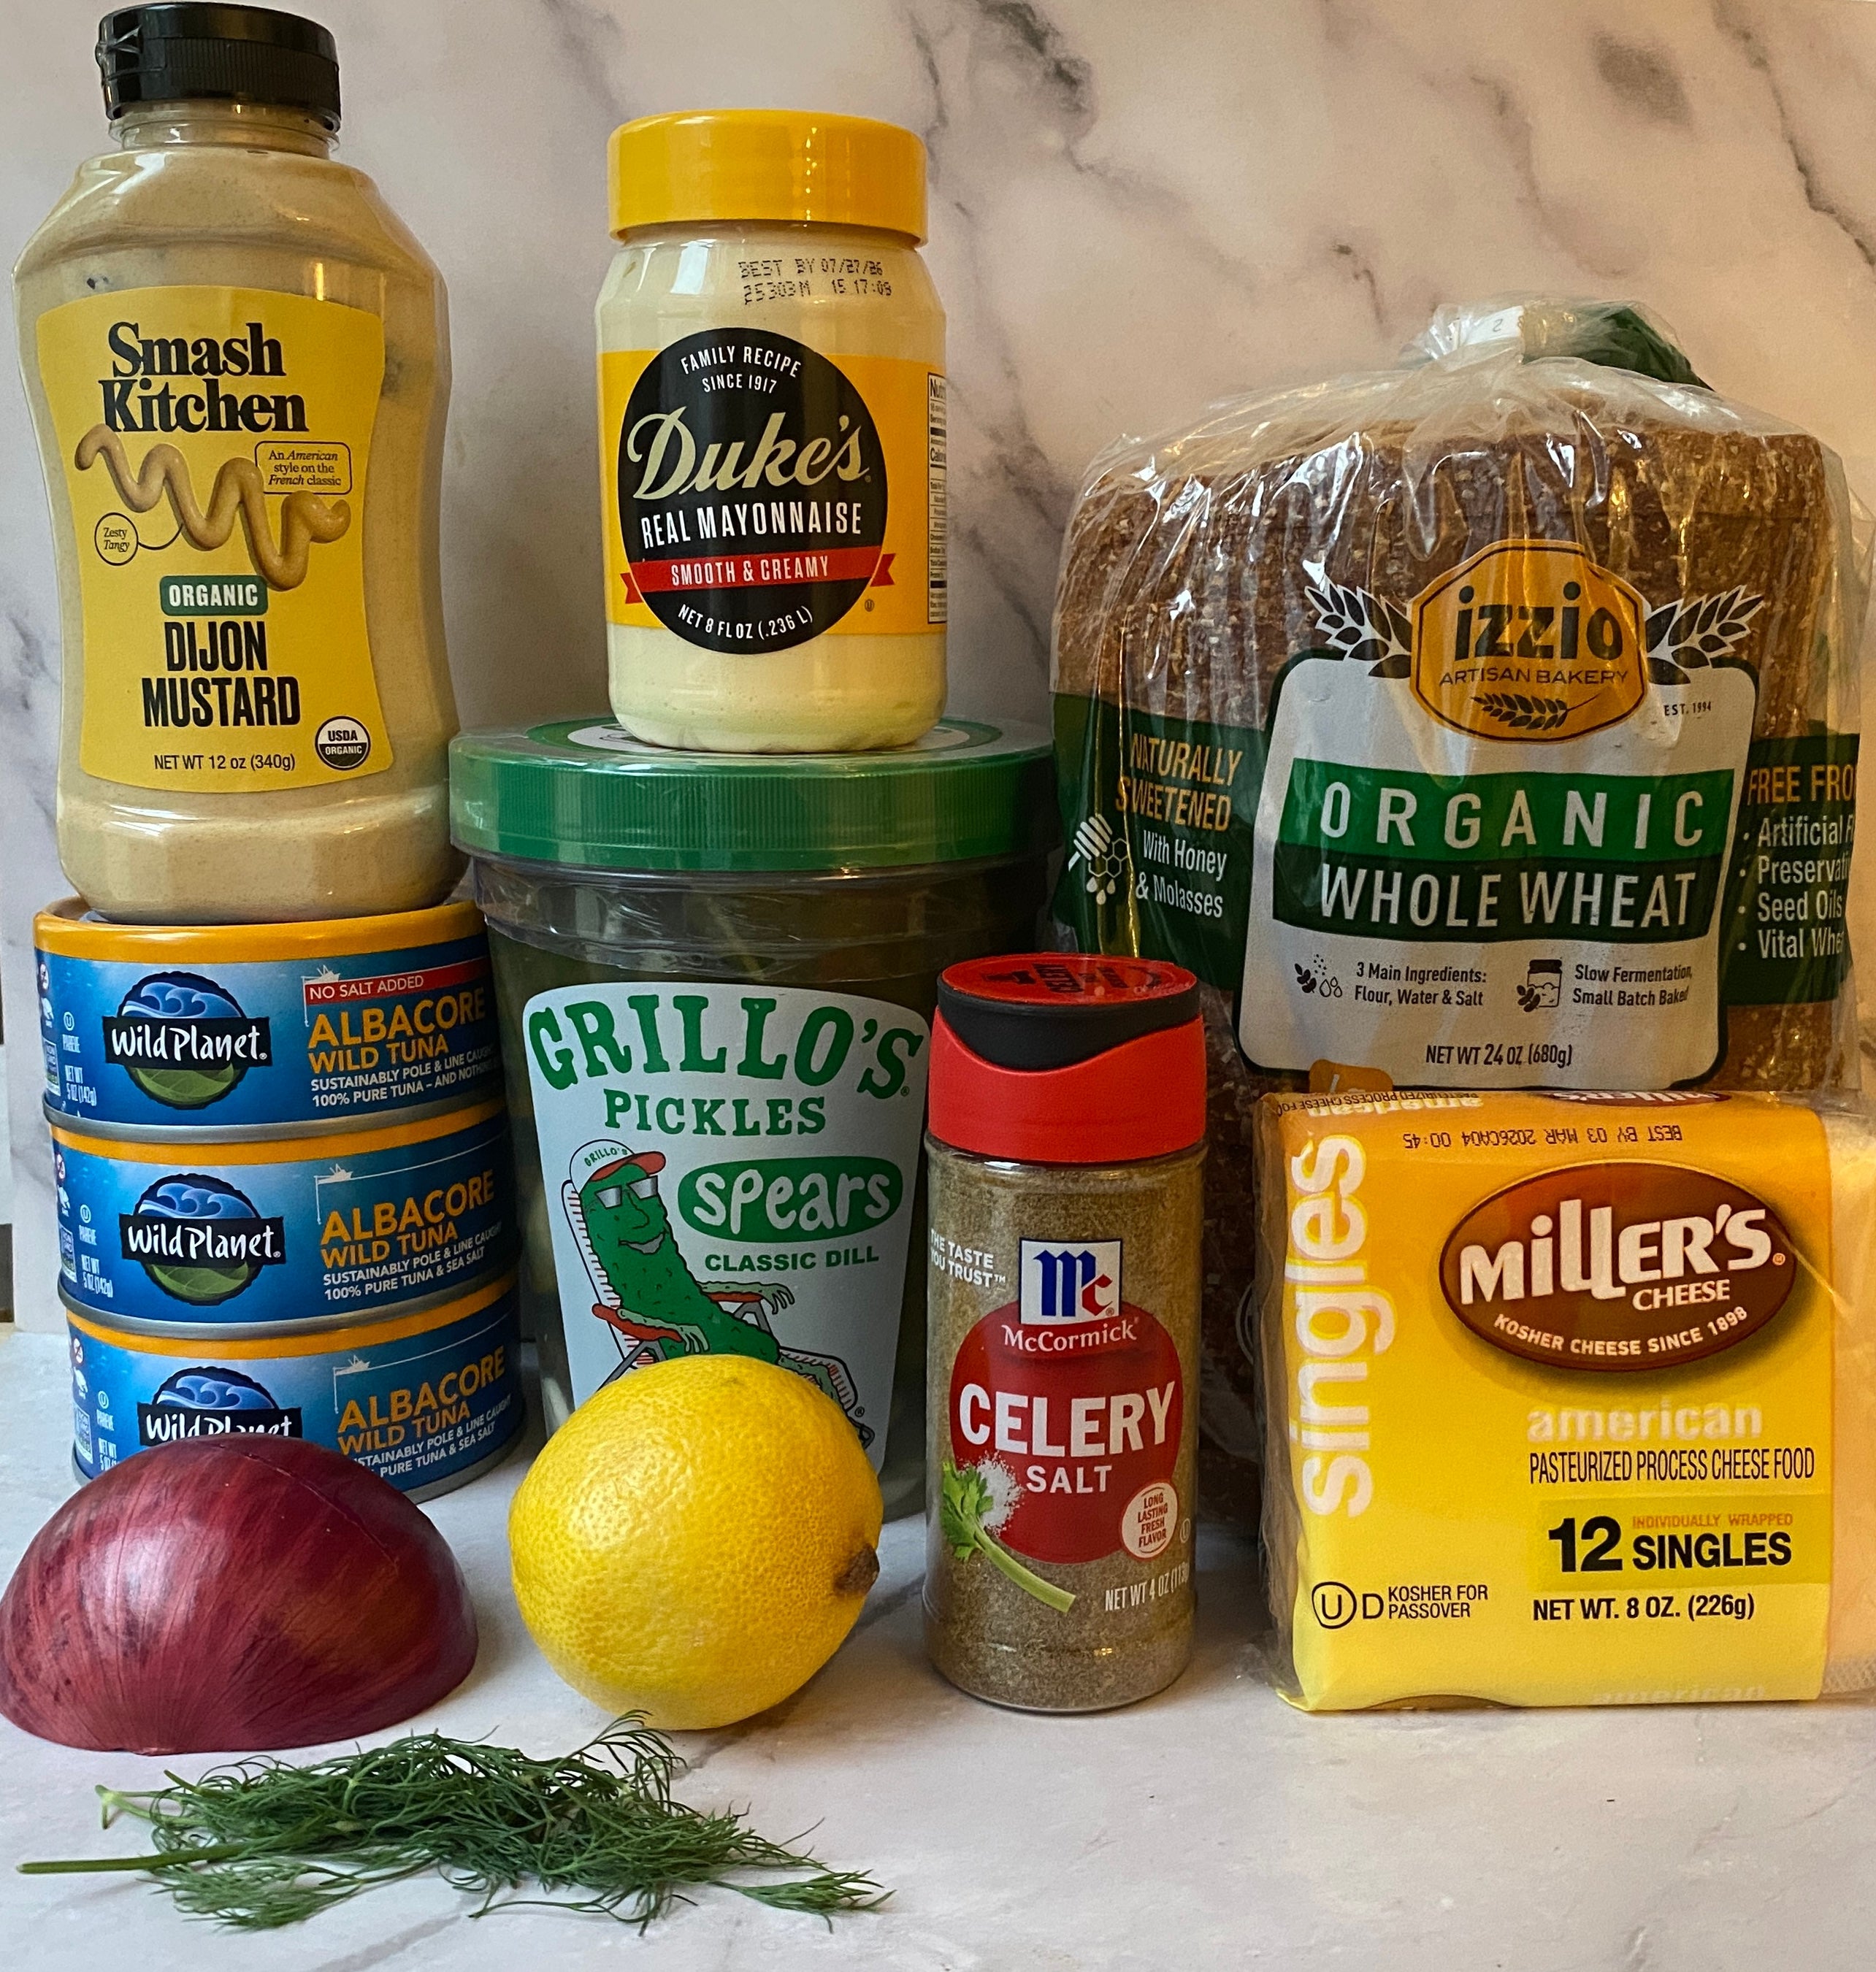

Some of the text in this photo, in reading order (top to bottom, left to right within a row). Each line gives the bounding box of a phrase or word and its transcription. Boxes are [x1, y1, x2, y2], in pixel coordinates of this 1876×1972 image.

[738, 259, 783, 278] BEST
[795, 258, 815, 275] BY
[108, 321, 286, 377] Smash
[681, 345, 802, 378] FAMILY RECIPE
[702, 373, 777, 394] SINCE 1917
[99, 378, 309, 432] Kitchen
[269, 450, 338, 461] An American
[274, 462, 334, 475] style on the
[627, 405, 870, 500] Duke's
[268, 475, 342, 486] French classic
[104, 526, 128, 540] Zesty
[640, 502, 862, 549] REAL MAYONNAISE
[104, 539, 130, 553] Tangy
[671, 555, 830, 587] SMOOTH & CREAMY
[169, 583, 259, 607] ORGANIC
[678, 604, 704, 628] NET
[705, 617, 714, 634] 8
[717, 622, 732, 639] FL
[735, 623, 754, 640] OZ
[1454, 581, 1623, 661] izzio
[164, 620, 267, 672] DIJON
[1439, 667, 1628, 686] ARTISAN BAKERY
[142, 675, 301, 728] MUSTARD
[1691, 701, 1712, 713] 1994
[324, 744, 363, 756] ORGANIC
[327, 730, 359, 743] USDA
[154, 753, 296, 772] NET WT 12 oz (340g)
[1130, 733, 1242, 786] NATURALLY
[1747, 766, 1801, 805] FREE
[1116, 774, 1232, 832] SWEETENED
[1320, 781, 1704, 849] ORGANIC
[1758, 814, 1842, 847] Artificial
[1144, 829, 1227, 882] With Honey
[1136, 872, 1223, 918] & Molasses
[1320, 862, 1695, 929] WHOLE WHEAT
[1758, 890, 1842, 922] Seed Oils
[1758, 928, 1804, 959] Vital
[310, 975, 424, 1000] NO SALT ADDED
[1356, 962, 1487, 985] 3 Main Ingredients:
[1574, 964, 1609, 982] Slow
[1355, 985, 1483, 1006] Flour, Water & Salt
[1573, 989, 1613, 1005] Small
[1616, 989, 1655, 1006] Batch
[308, 986, 486, 1048] ALBACORE
[112, 1024, 168, 1060] Wild
[169, 1025, 260, 1061] Planet
[308, 1034, 449, 1074] WILD TUNA
[528, 994, 924, 1100] GRILLO'S
[1426, 1043, 1573, 1068] NET WT 24 OZ (680g)
[311, 1053, 464, 1091] SUSTAINABLY POLE LINE
[312, 1072, 457, 1108] 100% PURE TUNA AND
[604, 1089, 827, 1137] PICKLES
[1545, 1128, 1577, 1143] MAR
[1587, 1127, 1607, 1143] 03
[1617, 1127, 1637, 1141] BY
[1648, 1125, 1682, 1141] BEST
[584, 1147, 628, 1167] GRILLO'S
[321, 1168, 494, 1246] ALBACORE
[693, 1169, 890, 1235] spears
[128, 1224, 184, 1258] Wild
[185, 1225, 275, 1260] Planet
[321, 1221, 459, 1269] WILD TUNA
[931, 1228, 994, 1270] THE TASTE
[323, 1240, 473, 1286] SUSTAINABLY POLE LINE
[324, 1246, 485, 1300] 100% PURE TUNA SEA SALT
[705, 1246, 880, 1273] CLASSIC DILL
[930, 1248, 946, 1271] YOU
[1632, 1279, 1731, 1311] CHEESE
[1001, 1319, 1137, 1352] McCormick
[1285, 1134, 1396, 1519] singles
[1494, 1305, 1747, 1356] KOSHER CHEESE SINCE 1898
[337, 1346, 505, 1433] ALBACORE
[337, 1401, 471, 1456] WILD TUNA
[959, 1380, 1176, 1457] CELERY
[1527, 1398, 1762, 1443] american
[1026, 1465, 1113, 1494] SALT
[1530, 1447, 1815, 1484] PASTEURIZED PROCESS CHEESE FOOD
[1137, 1503, 1168, 1524] LASTING
[1143, 1492, 1164, 1509] LONG
[1141, 1516, 1165, 1535] FRESH
[1632, 1513, 1793, 1529] INDIVIDUALLY WRAPPED
[1138, 1529, 1167, 1549] FLAVOR
[1548, 1515, 1792, 1573] 12 SINGLES
[1105, 1571, 1170, 1612] NET WT 4 OZ
[1388, 1584, 1488, 1603] KOSHER FOR
[1534, 1593, 1755, 1622] NET WT. 8 OZ. (226g)
[1388, 1602, 1471, 1619] PASSOVER
